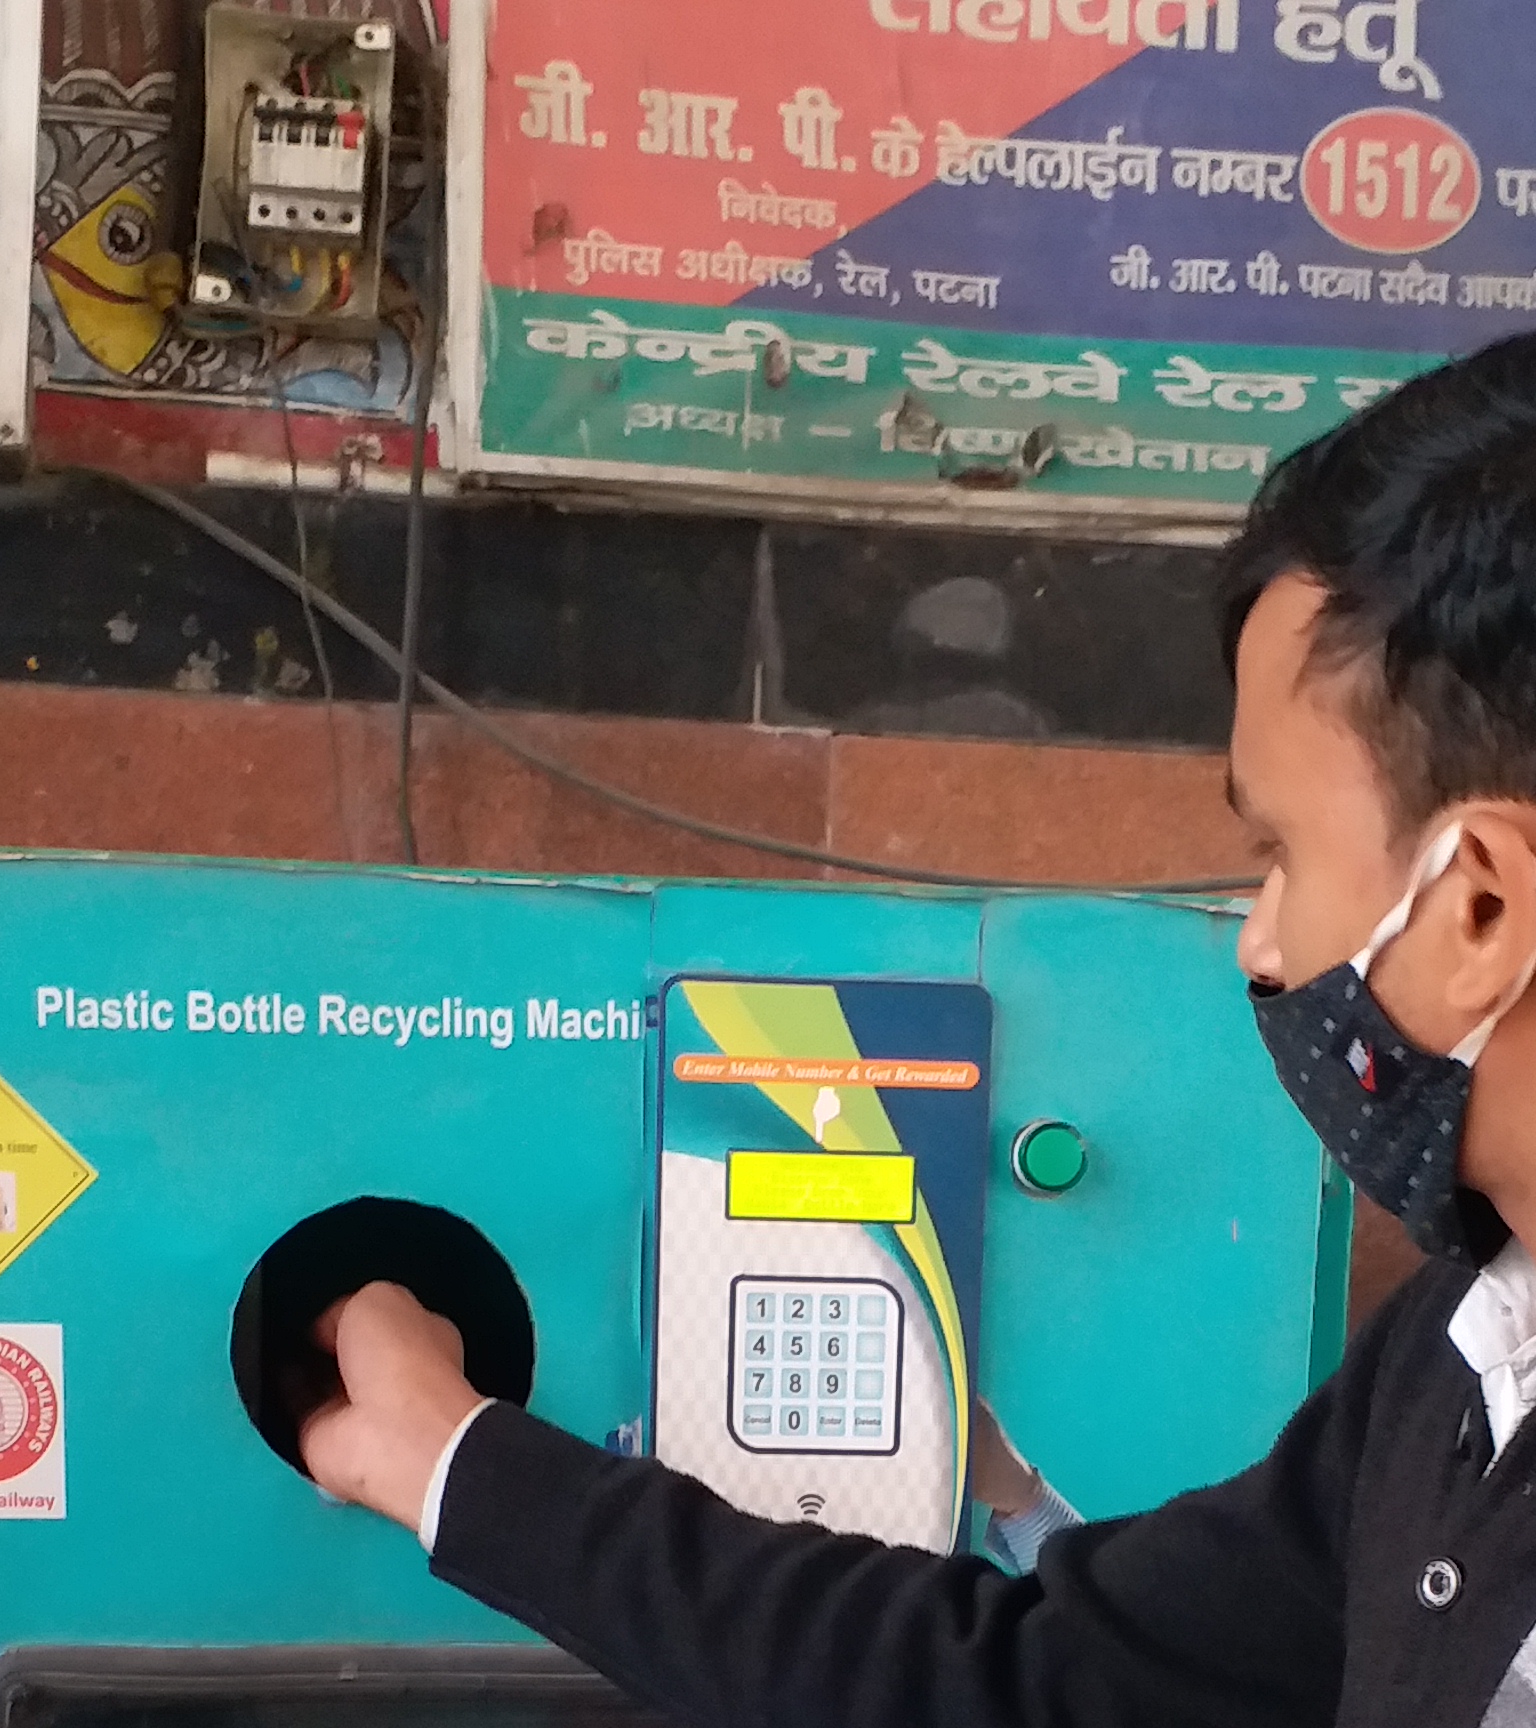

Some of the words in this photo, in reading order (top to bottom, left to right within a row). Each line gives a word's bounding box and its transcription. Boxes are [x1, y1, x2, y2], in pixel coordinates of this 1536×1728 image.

[514, 60, 607, 148] जी.
[638, 88, 754, 162] आर.
[777, 87, 857, 171] पी.
[871, 116, 923, 178] के
[1172, 147, 1300, 202] नम्बर
[1319, 137, 1464, 223] 1512
[563, 227, 663, 286] पुलिस
[913, 267, 1000, 309] पटना
[1109, 244, 1161, 291] जी.
[1168, 258, 1237, 293] आर.
[1246, 249, 1290, 296] पी.
[901, 338, 1128, 404] रेलवे
[1154, 355, 1317, 412] रेल
[37, 987, 174, 1032] Plastic
[186, 990, 306, 1036] Bottle
[319, 994, 514, 1049] Recycling
[525, 998, 648, 1041] Machi
[682, 1059, 724, 1077] Enter
[727, 1060, 780, 1078] Mobile
[784, 1062, 844, 1080] Number
[865, 1066, 891, 1083] Get
[893, 1066, 969, 1085] Rewarded
[755, 1299, 766, 1318] 1
[791, 1300, 805, 1319] 2
[828, 1300, 842, 1319] 3
[752, 1336, 766, 1355] 4
[790, 1337, 803, 1356] 5
[827, 1338, 840, 1357] 6
[27, 1366, 55, 1453] RAILWAYS
[752, 1373, 765, 1392] 7
[789, 1374, 802, 1393] 8
[826, 1374, 839, 1394] 9
[788, 1410, 801, 1431] 0
